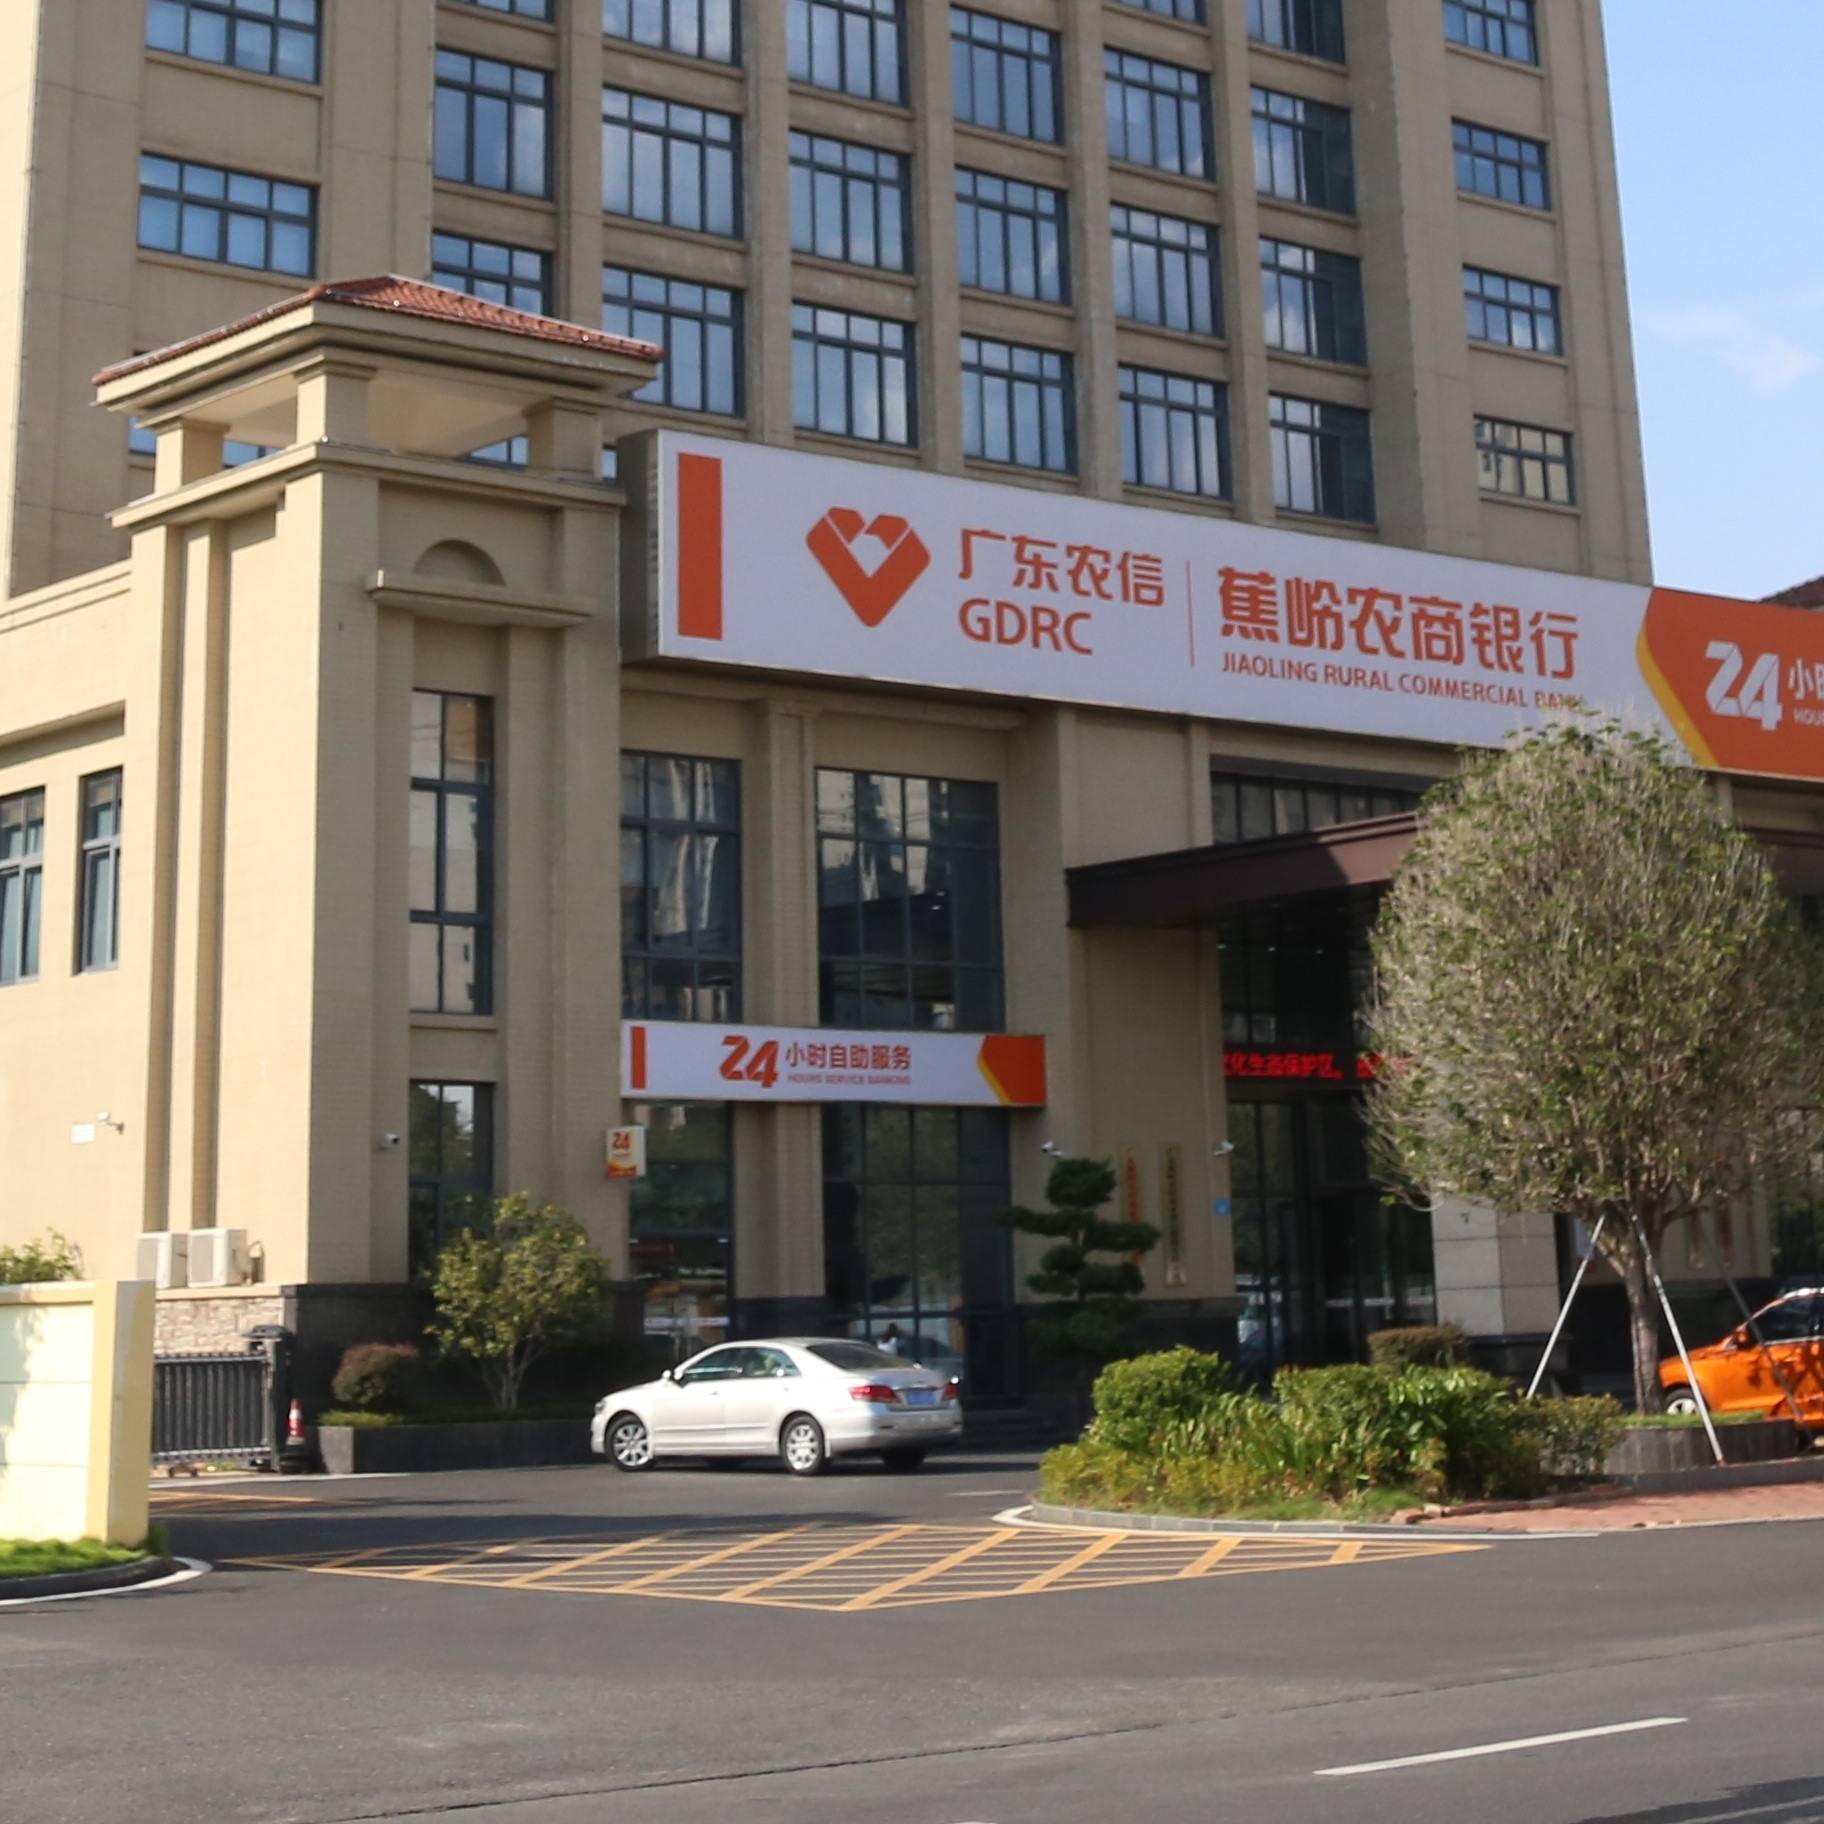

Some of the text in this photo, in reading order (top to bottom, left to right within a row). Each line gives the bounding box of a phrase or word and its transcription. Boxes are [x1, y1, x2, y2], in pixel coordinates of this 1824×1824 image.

[958, 528, 1165, 607] 广东农信
[958, 597, 1093, 655] GDRC
[1217, 566, 1580, 681] 蕉岭农商银行
[1222, 651, 1317, 684] JIAOLING
[1324, 663, 1393, 693] RURAL
[1398, 672, 1528, 709] COMMERCIAL
[1705, 640, 1782, 731] 24
[719, 1034, 911, 1088] 24 小时自助服务
